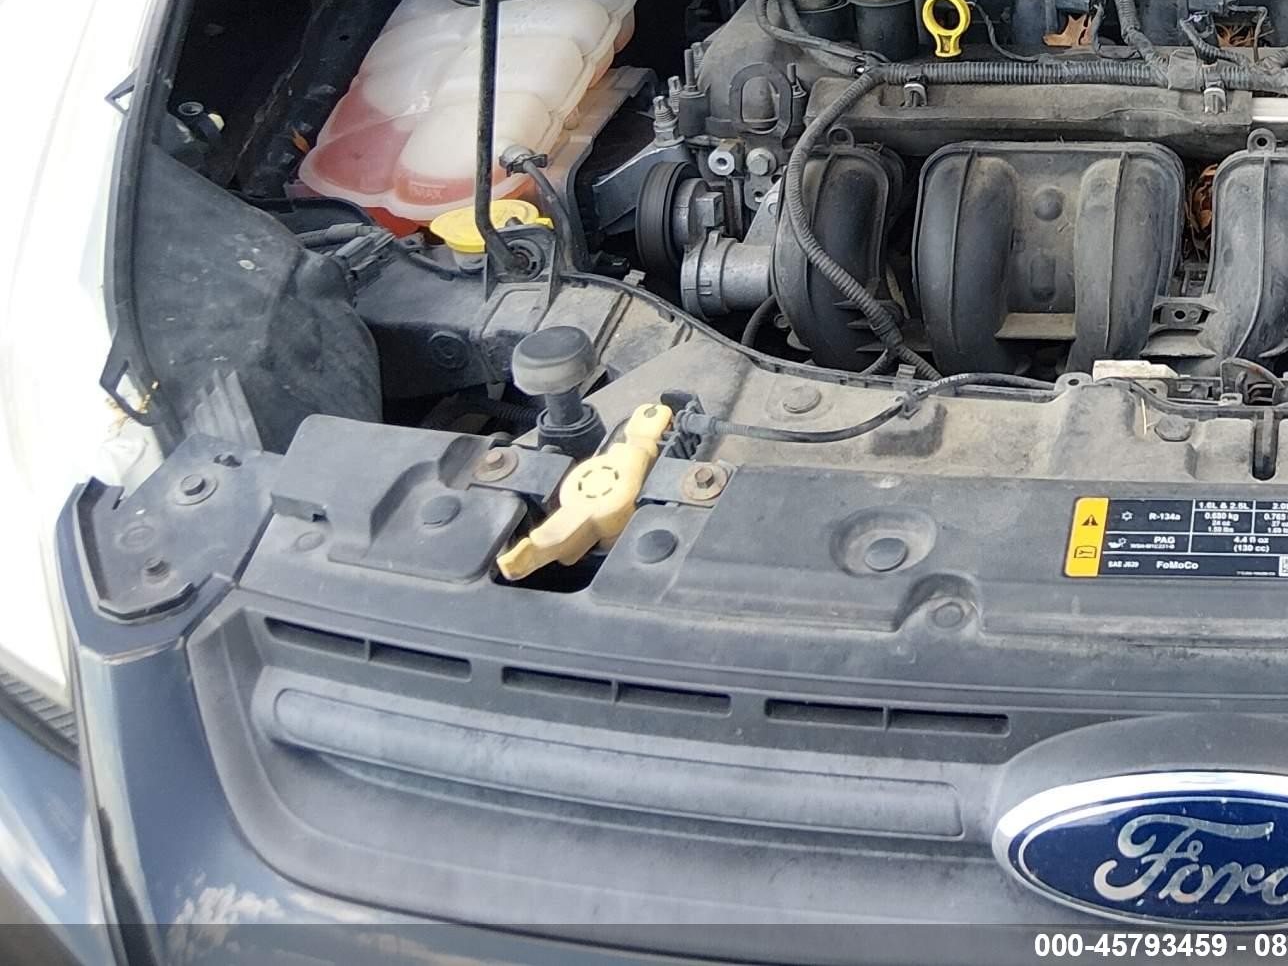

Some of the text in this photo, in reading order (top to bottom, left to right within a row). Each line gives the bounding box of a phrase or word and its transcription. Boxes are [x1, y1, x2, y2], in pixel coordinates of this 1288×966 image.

[1199, 501, 1218, 509] 1.6L
[1229, 502, 1250, 510] 2.5L
[1148, 512, 1182, 521] R-134a
[1228, 512, 1239, 522] kg
[1153, 536, 1176, 544] PAG
[1156, 560, 1200, 570] FoMoCo
